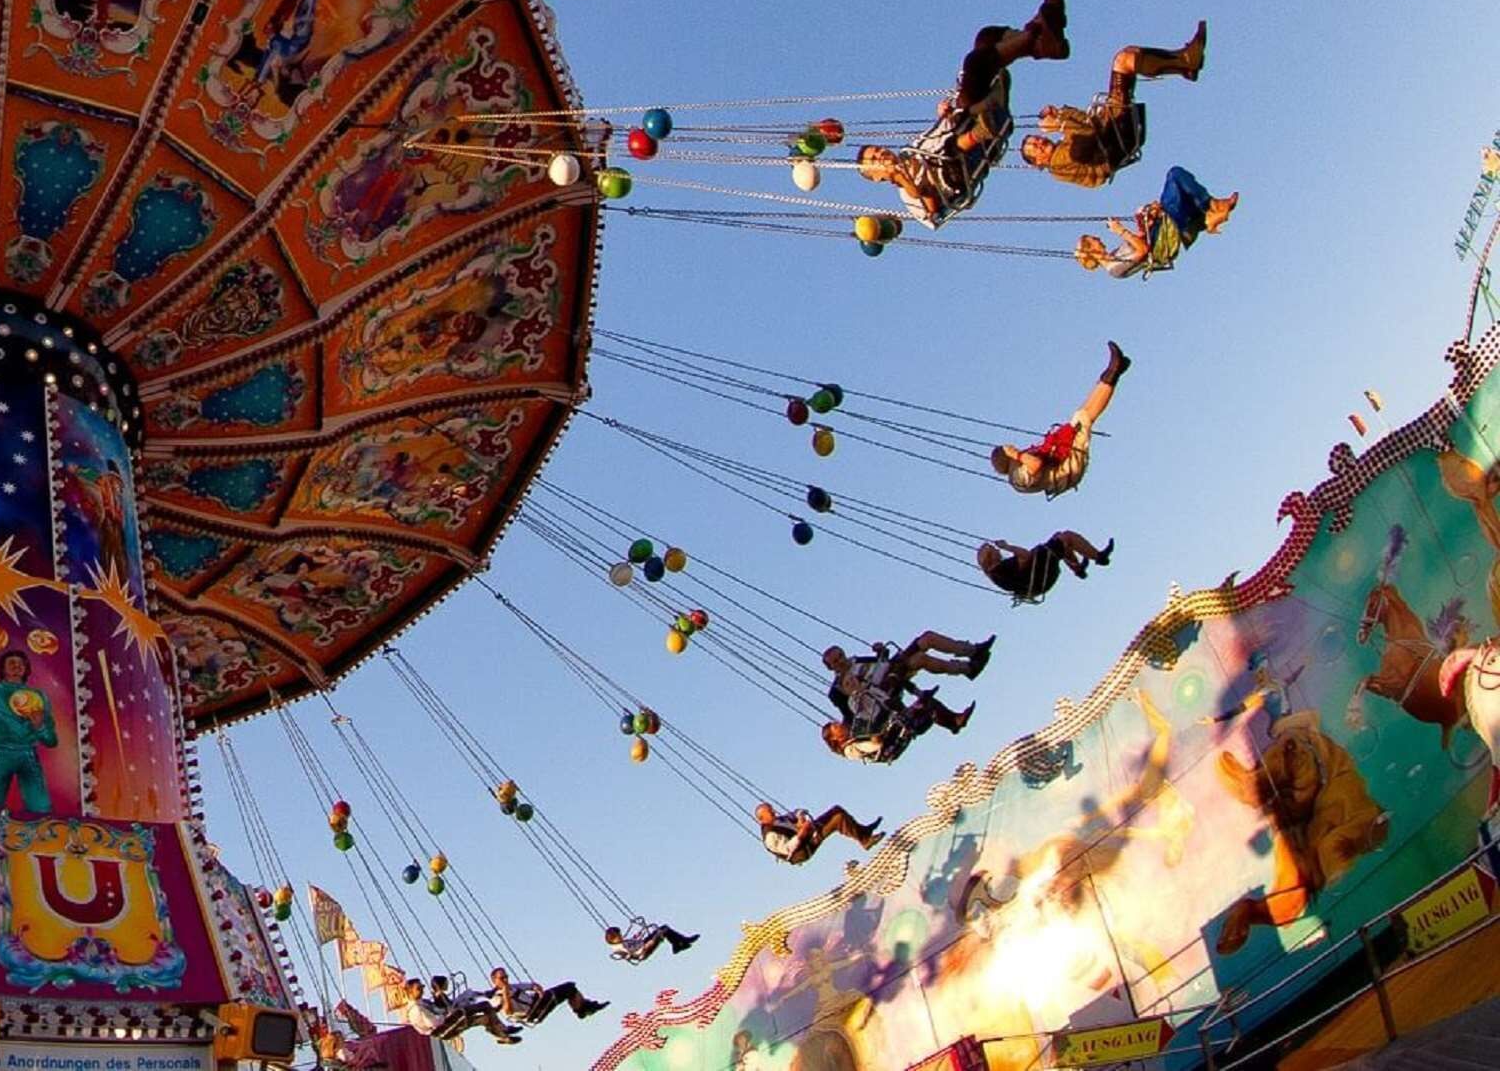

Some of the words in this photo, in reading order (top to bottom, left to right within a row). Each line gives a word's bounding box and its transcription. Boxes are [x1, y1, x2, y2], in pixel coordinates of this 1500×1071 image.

[34, 854, 125, 926] U
[1077, 1030, 1157, 1054] AUSGANG
[7, 1054, 100, 1071] Anordnungen
[106, 1057, 131, 1070] des
[137, 1056, 202, 1070] Personals
